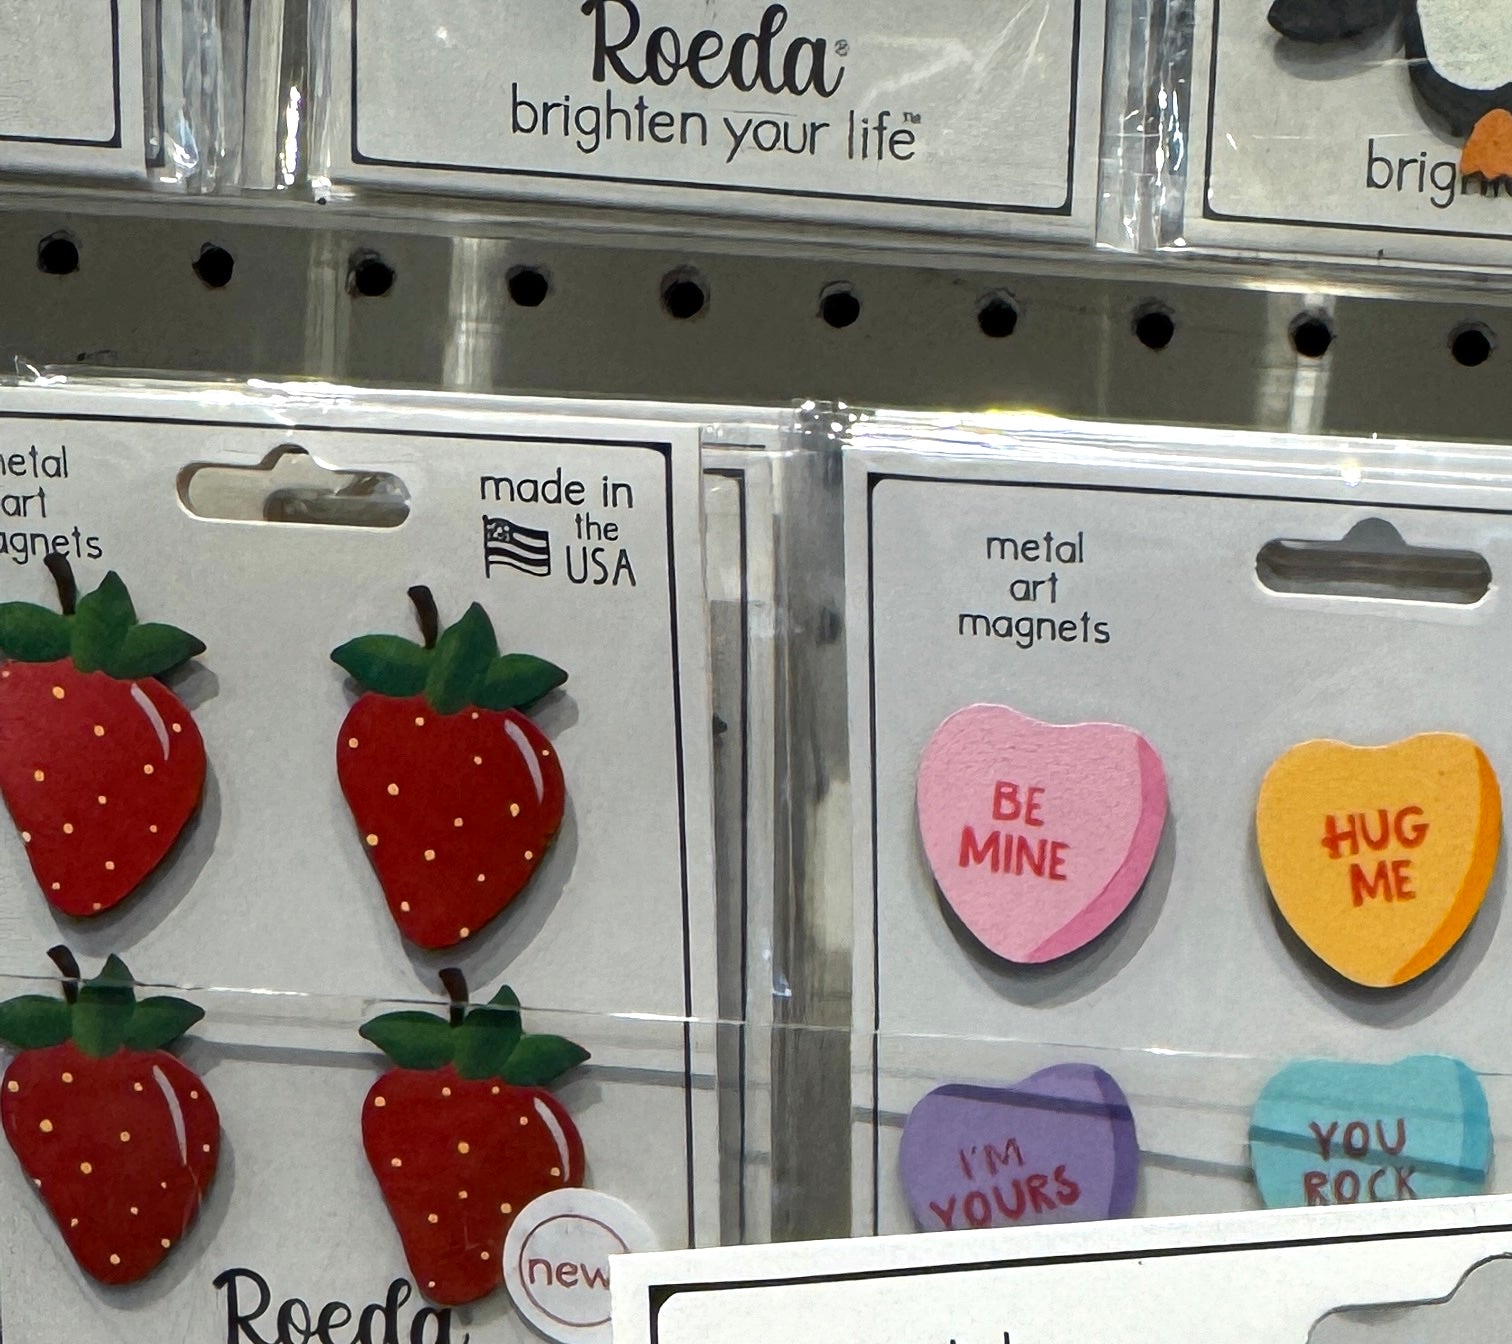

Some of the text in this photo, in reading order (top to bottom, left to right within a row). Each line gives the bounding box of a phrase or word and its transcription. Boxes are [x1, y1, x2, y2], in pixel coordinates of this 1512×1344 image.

[512, 83, 707, 153] brighten
[724, 116, 830, 163] your
[0, 445, 68, 478] etal
[1, 486, 46, 518] art
[481, 468, 634, 509] made in
[574, 514, 619, 541] the
[986, 531, 1084, 563] metal
[566, 547, 637, 587] USA
[1009, 571, 1058, 603] art
[958, 611, 1111, 649] magnets
[991, 780, 1046, 827] BE
[1322, 806, 1430, 860] HUG
[957, 826, 1071, 881] MINE
[1350, 859, 1417, 907] ME
[958, 1137, 1026, 1181] I'M
[1308, 1117, 1407, 1162] YOU
[929, 1164, 1082, 1231] YOURS
[1304, 1166, 1418, 1206] ROCK
[529, 1258, 611, 1290] new
